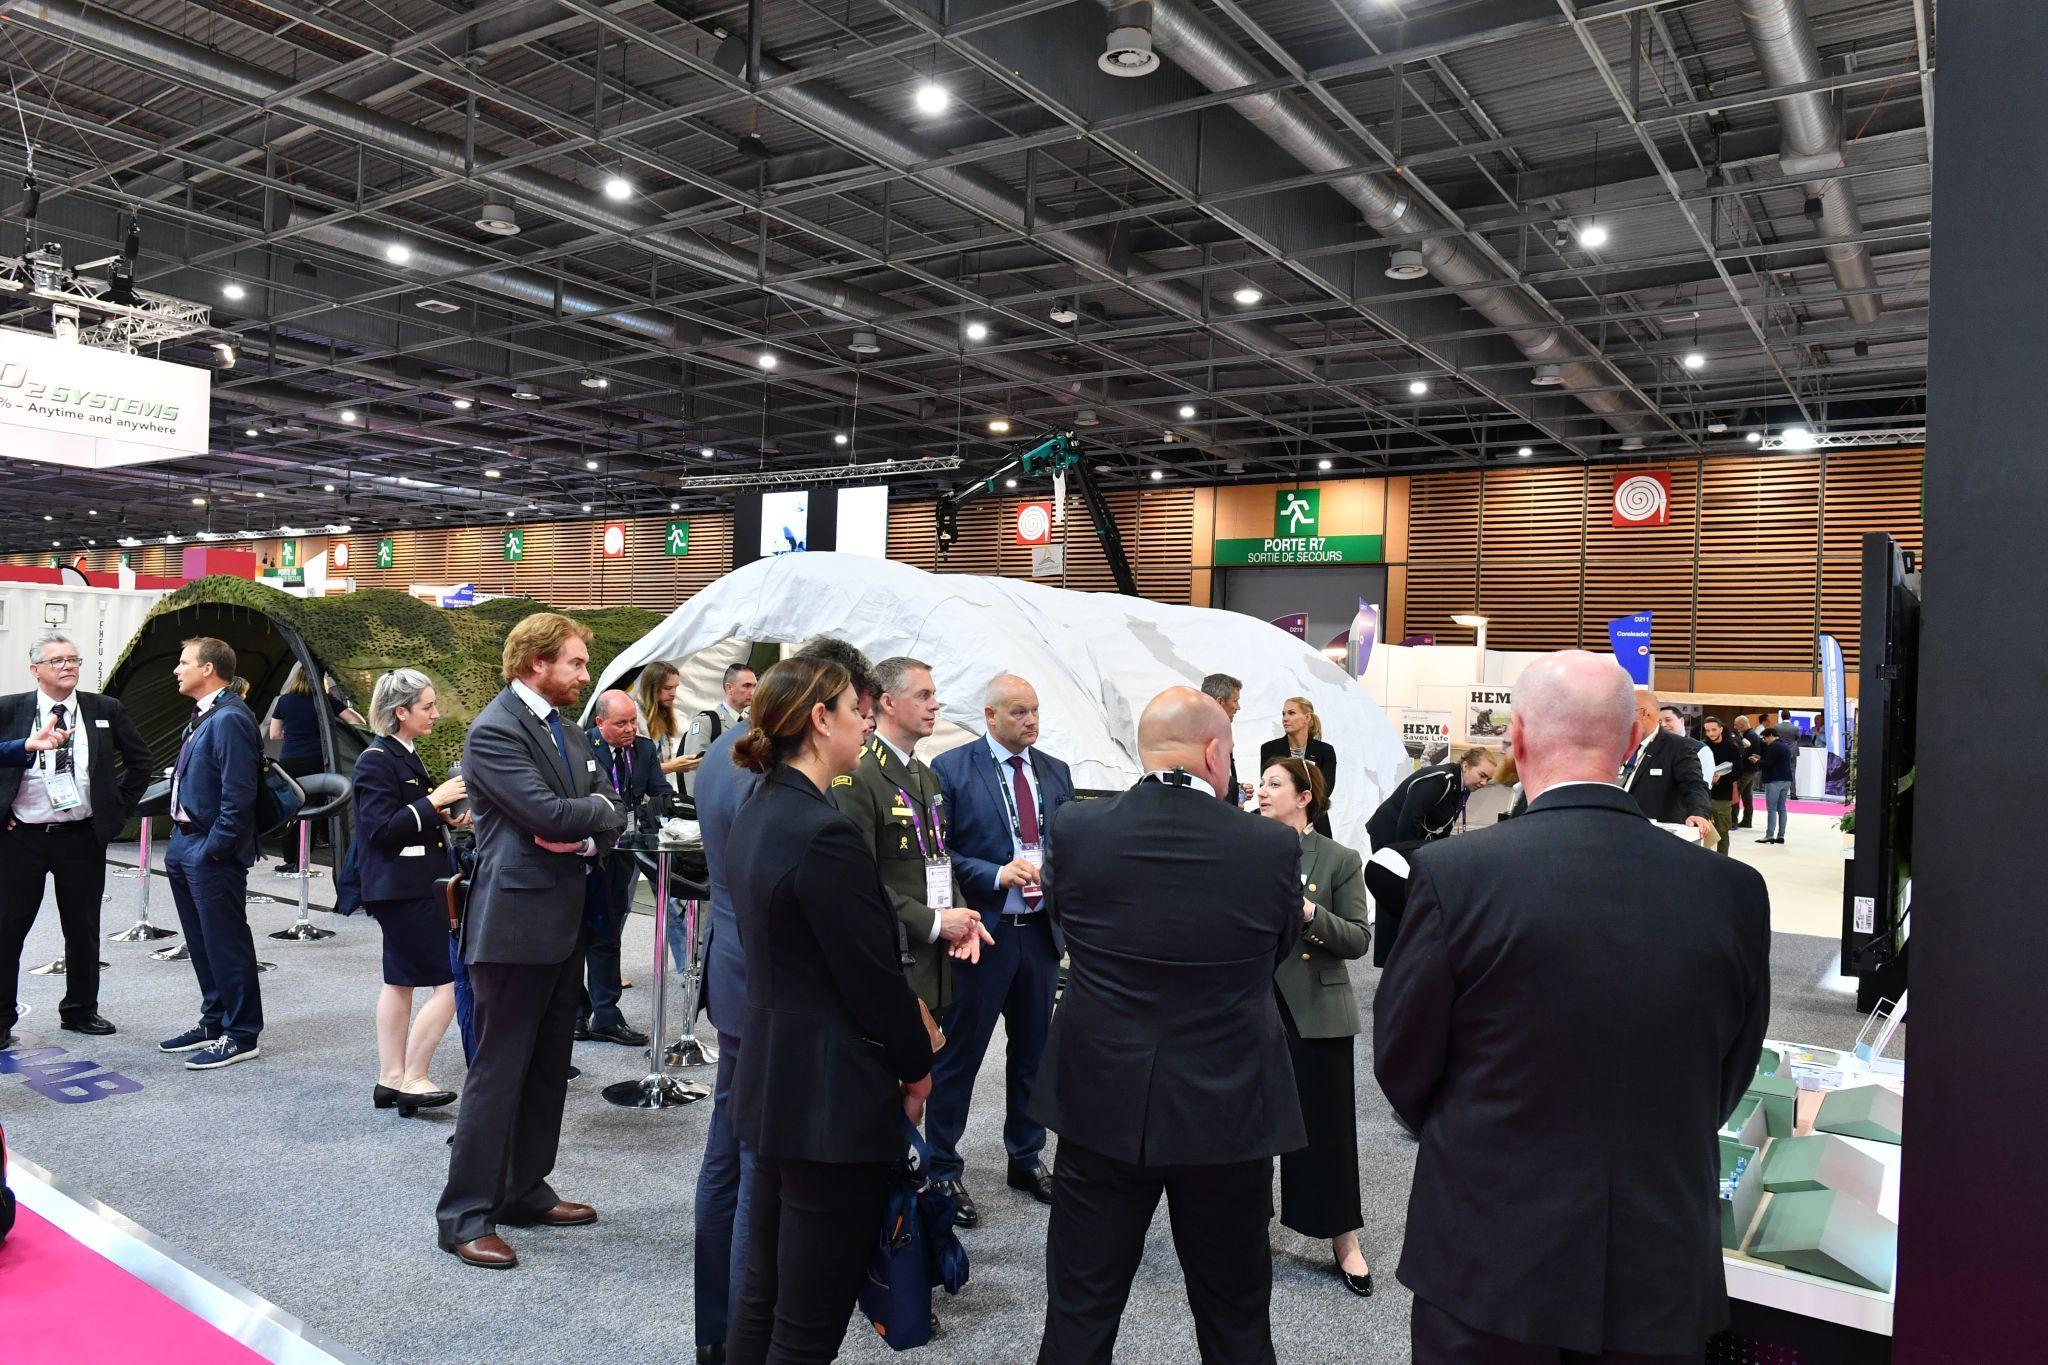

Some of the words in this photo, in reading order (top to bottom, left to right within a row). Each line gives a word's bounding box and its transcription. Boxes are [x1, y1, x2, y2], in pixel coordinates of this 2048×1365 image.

[50, 385, 179, 421] SYSTEMS
[28, 402, 84, 419] Anytime
[89, 414, 112, 424] and
[116, 419, 177, 434] anywhere
[1264, 538, 1306, 551] PORTE
[1309, 537, 1326, 551] R7
[1247, 552, 1280, 563] SORTIE
[1282, 551, 1294, 562] DE
[1296, 550, 1342, 562] SECOURS
[1471, 691, 1511, 704] HEM
[1403, 723, 1440, 735] HEM
